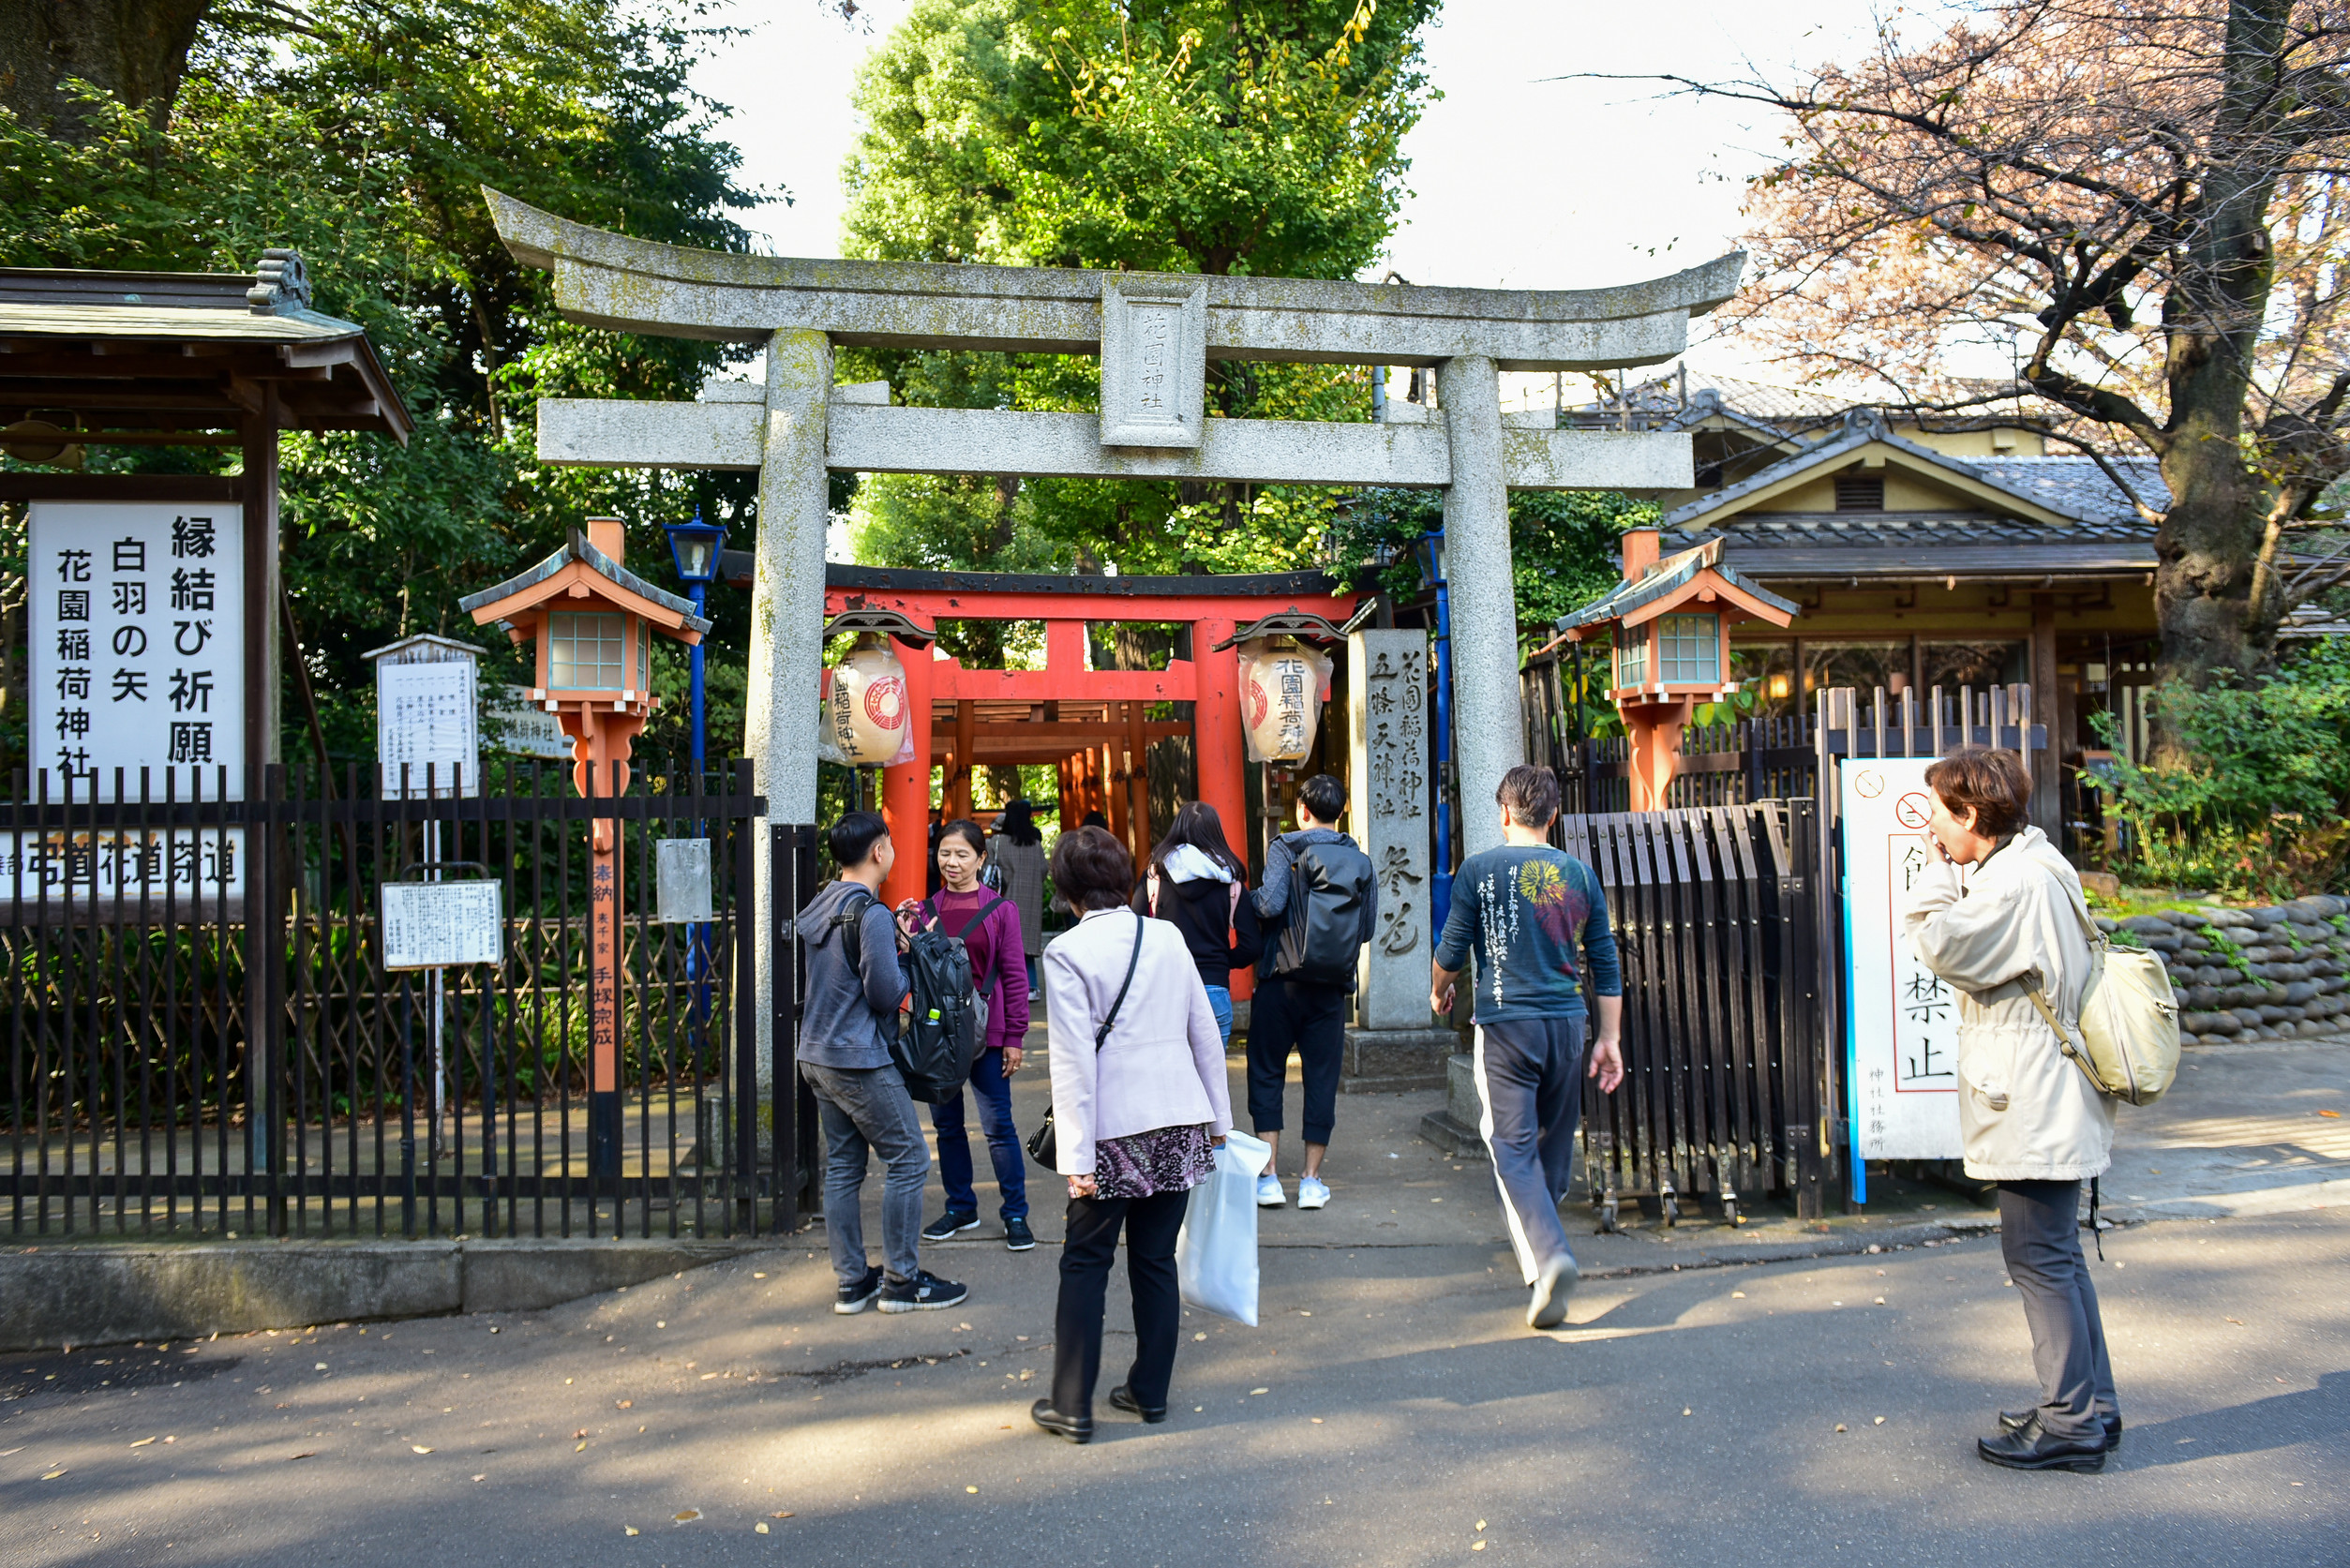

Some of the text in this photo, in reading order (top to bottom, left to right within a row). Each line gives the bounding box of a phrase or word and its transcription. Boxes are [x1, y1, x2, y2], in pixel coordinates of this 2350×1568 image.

[55, 549, 92, 780] 花園稲荷神社
[111, 536, 148, 703] 白羽の矢
[168, 515, 217, 765] 縁結び祈願
[593, 863, 614, 902] 奉納
[596, 912, 609, 955] 表千家
